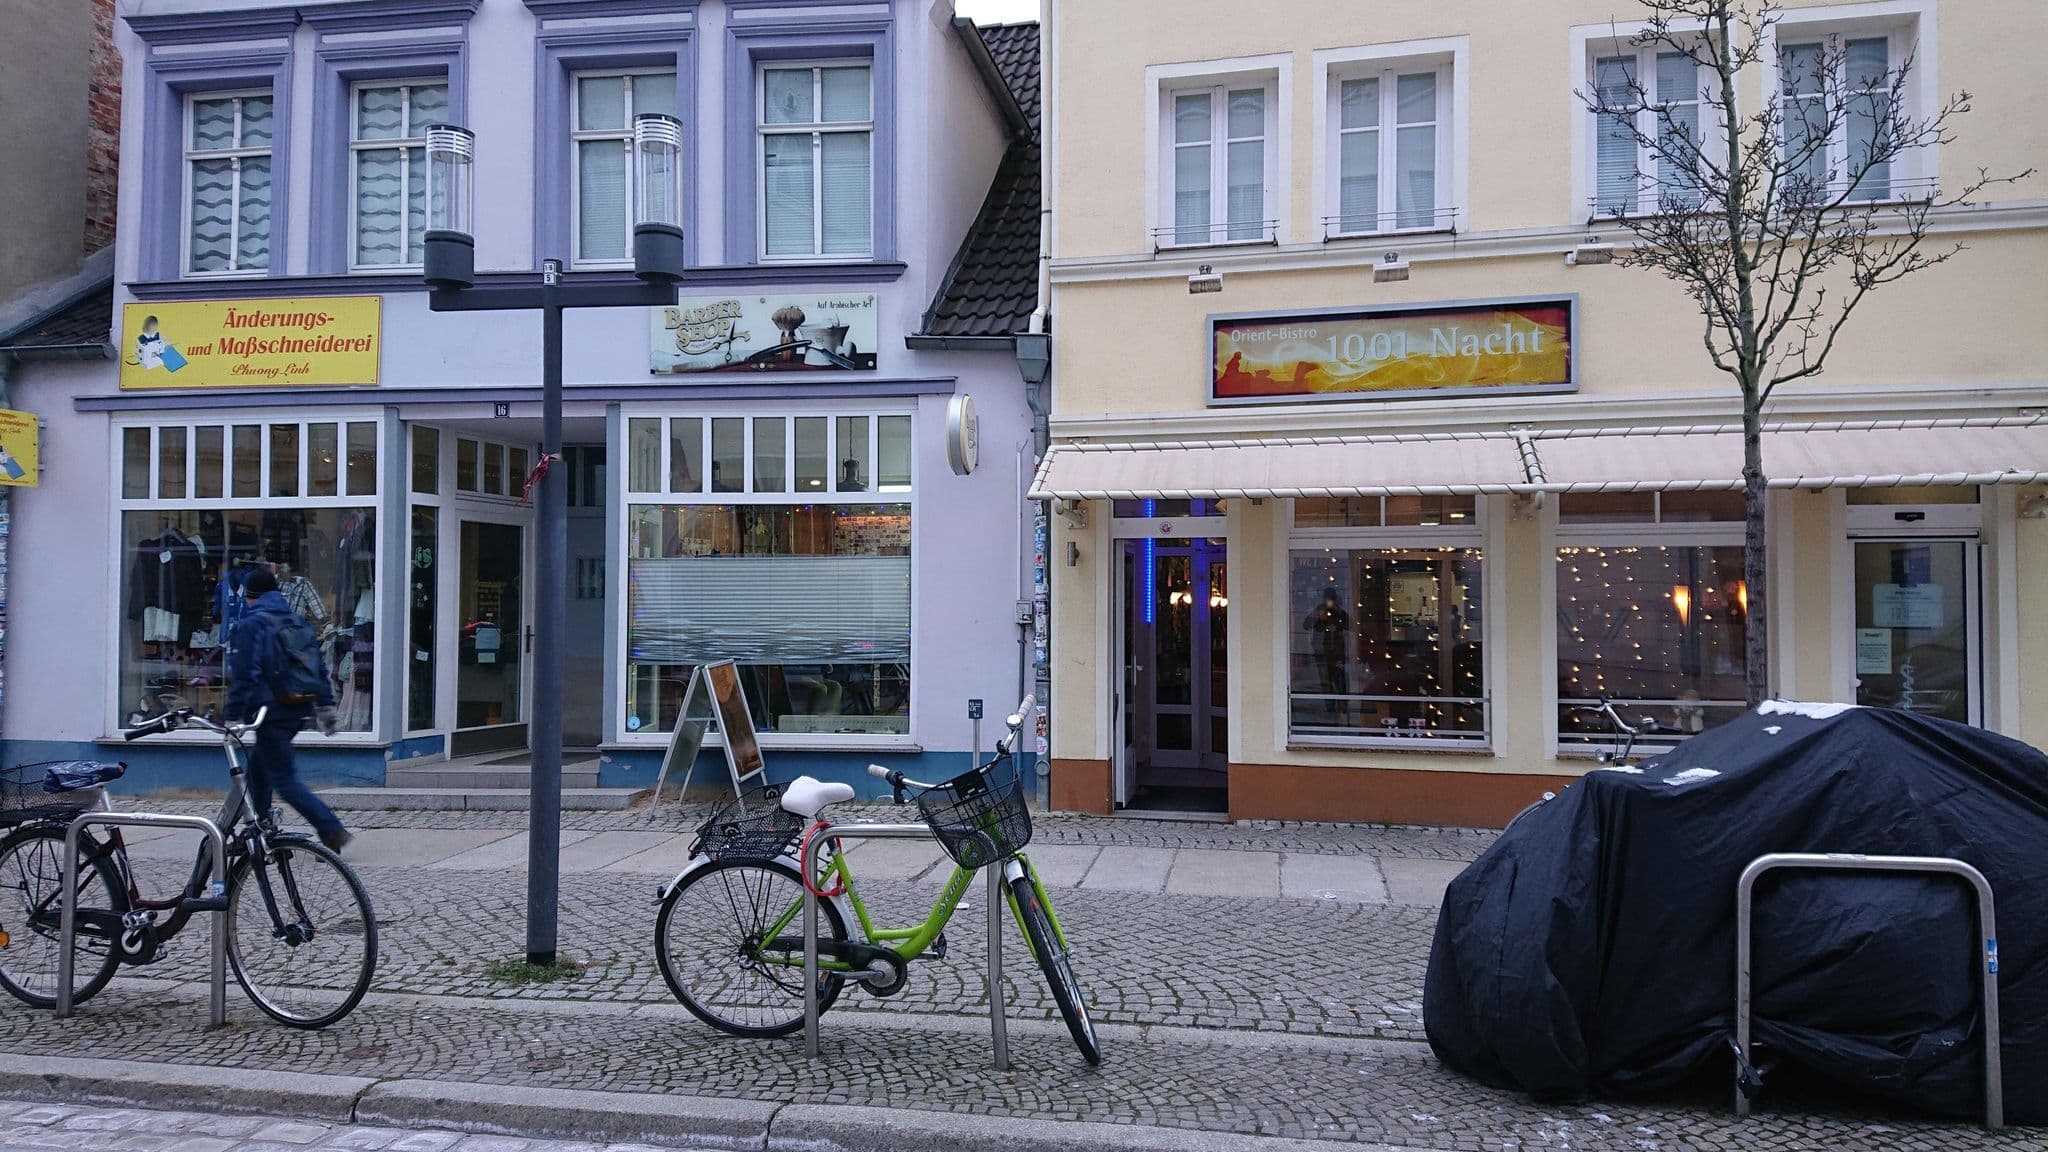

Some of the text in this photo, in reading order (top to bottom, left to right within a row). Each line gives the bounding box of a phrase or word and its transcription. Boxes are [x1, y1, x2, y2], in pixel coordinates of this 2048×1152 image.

[664, 299, 743, 330] BARBER
[817, 301, 827, 309] Auf
[829, 300, 861, 309] Arabischer
[223, 307, 335, 330] Änderungs-
[676, 319, 731, 348] SHOP
[1231, 327, 1317, 344] Orient-Bistro
[1326, 322, 1545, 364] 1001 Nacht
[187, 334, 372, 358] und Maßschneiderei
[230, 362, 310, 379] Phuong Linh
[497, 404, 506, 416] 16
